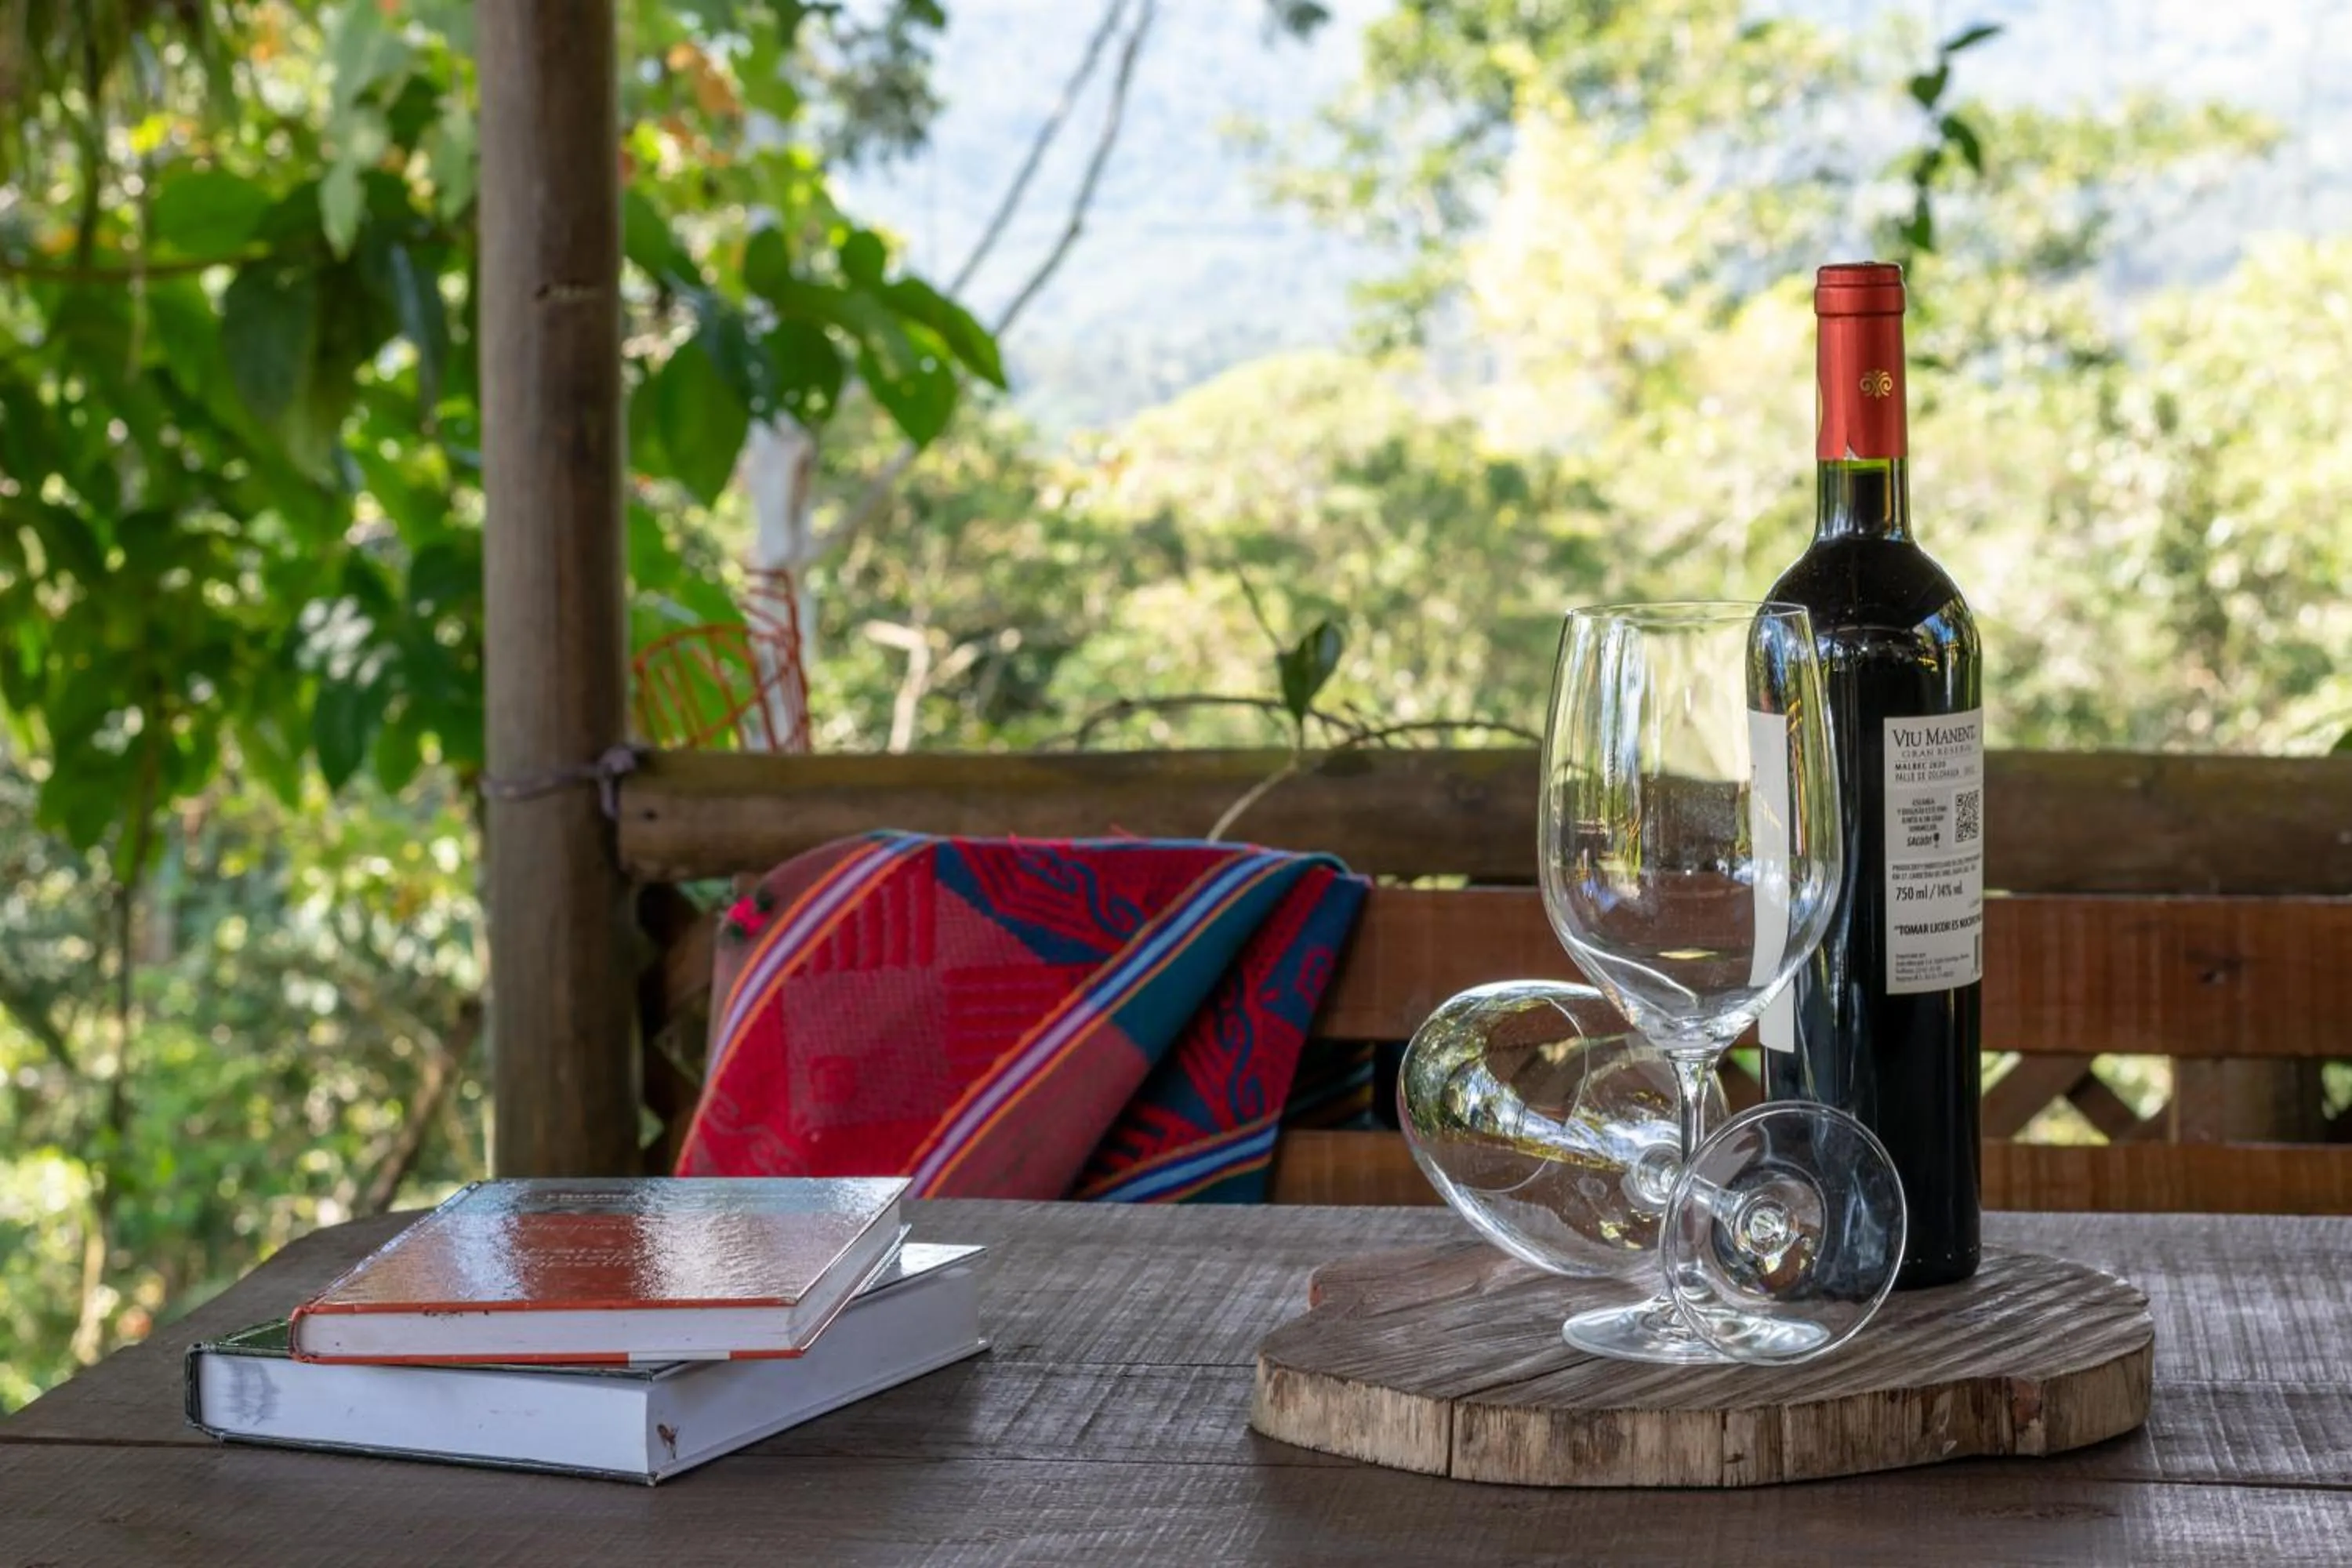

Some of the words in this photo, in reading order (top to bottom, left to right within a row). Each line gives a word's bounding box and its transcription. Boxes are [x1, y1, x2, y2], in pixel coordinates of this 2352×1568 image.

[1901, 749, 1934, 758] GRAN
[1895, 762, 1926, 771] MALBEC
[1896, 886, 1914, 901] 750
[1915, 884, 1928, 899] ml
[1937, 883, 1952, 898] 14%
[1929, 920, 1951, 934] LICOR
[1951, 919, 1958, 931] ES
